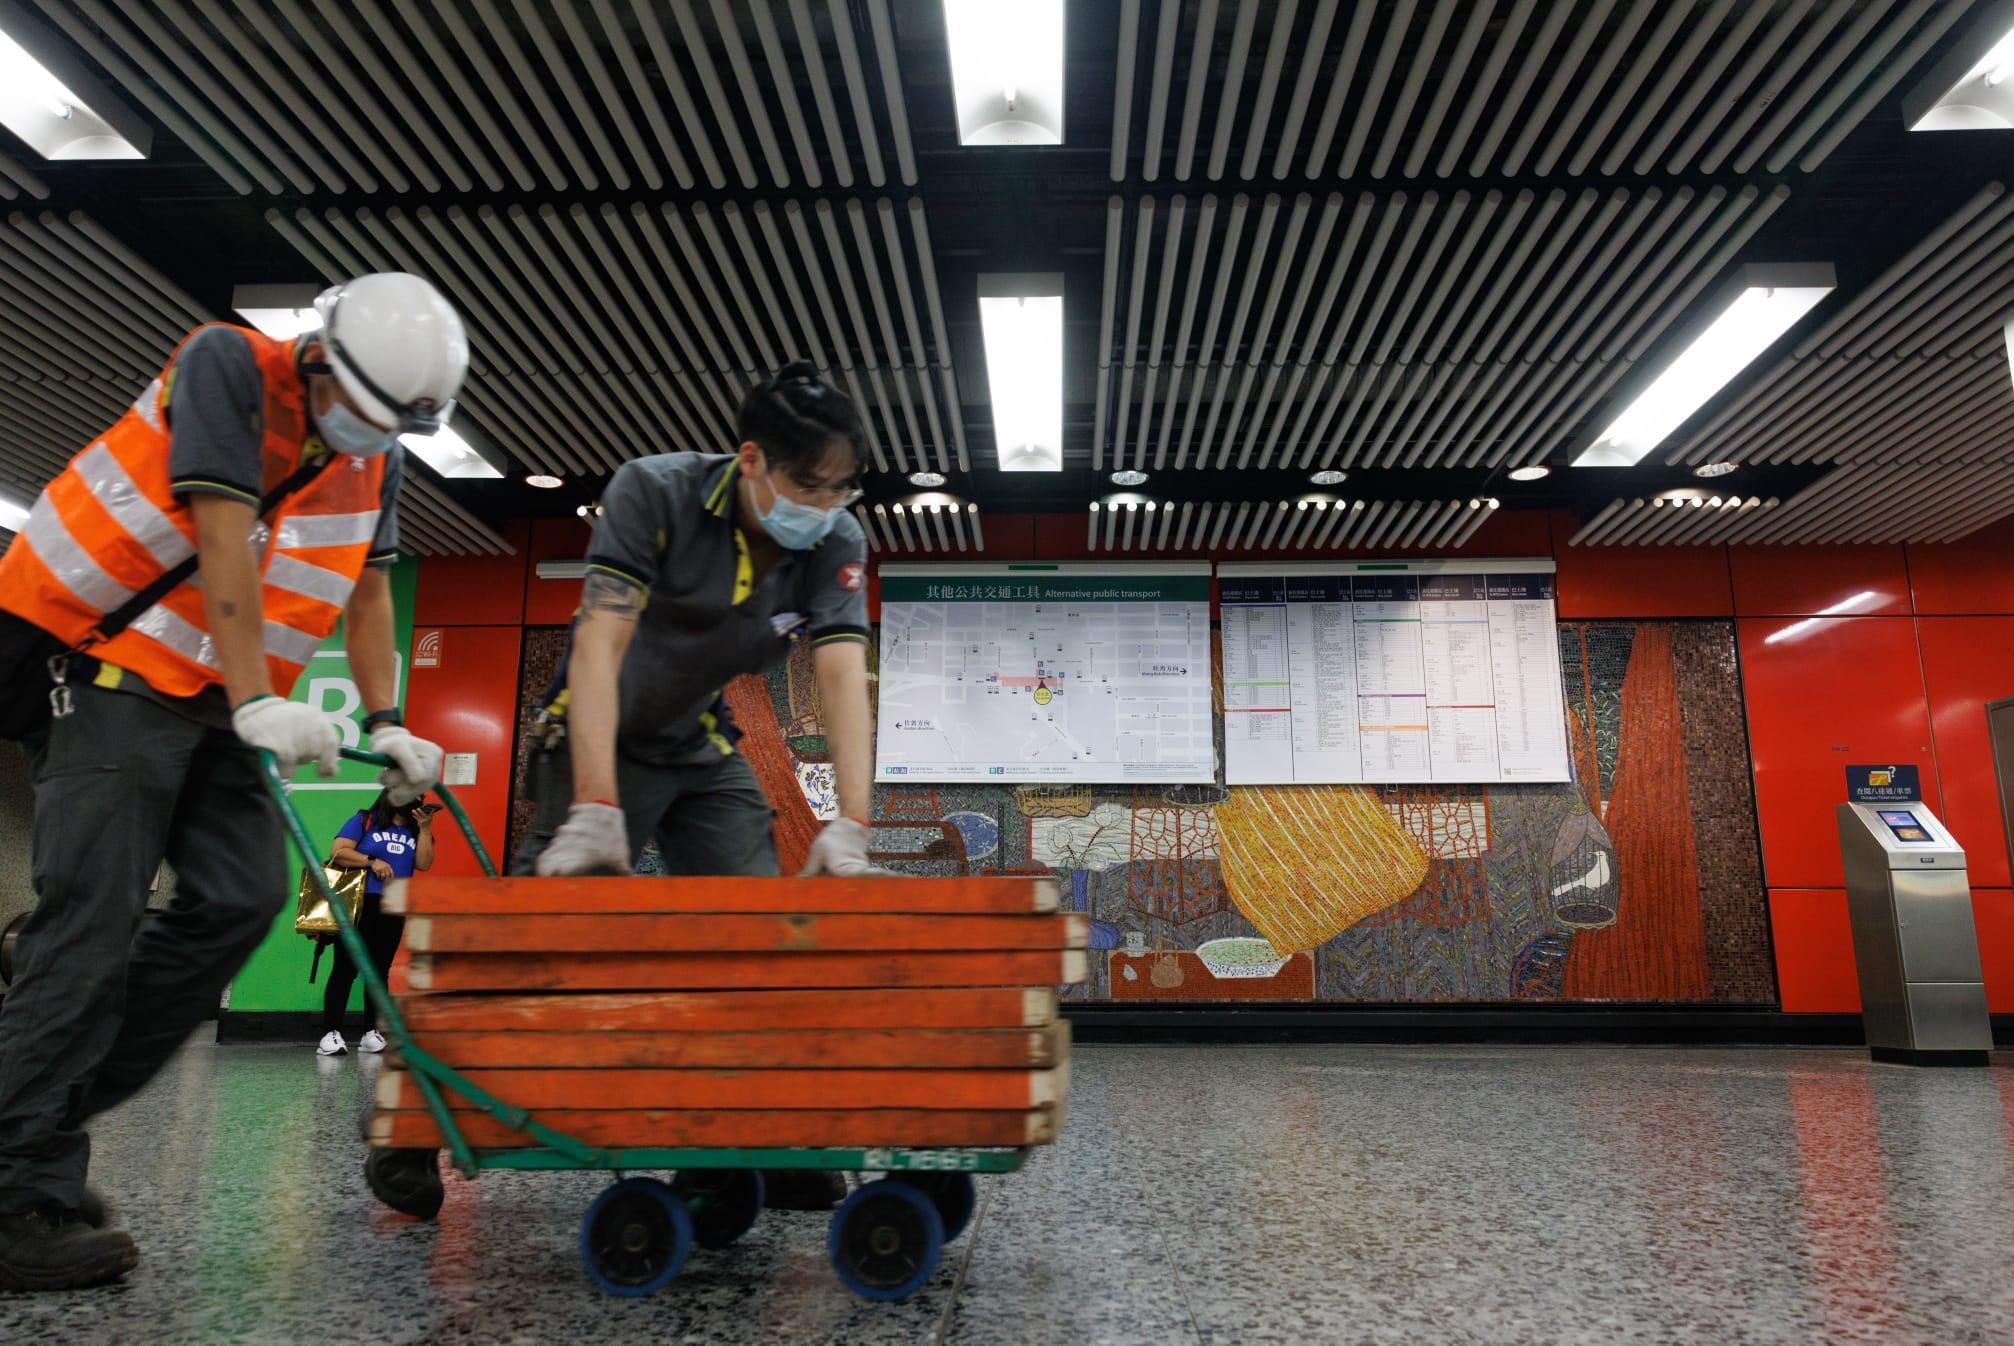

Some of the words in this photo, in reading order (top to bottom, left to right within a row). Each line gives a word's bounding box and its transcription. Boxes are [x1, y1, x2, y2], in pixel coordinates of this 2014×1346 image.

[926, 585, 1040, 599] 其他公共交通工具
[1045, 589, 1091, 598] Alternative
[1093, 589, 1119, 599] public
[1121, 590, 1161, 599] transport
[307, 677, 361, 749] B
[390, 844, 401, 852] BIG
